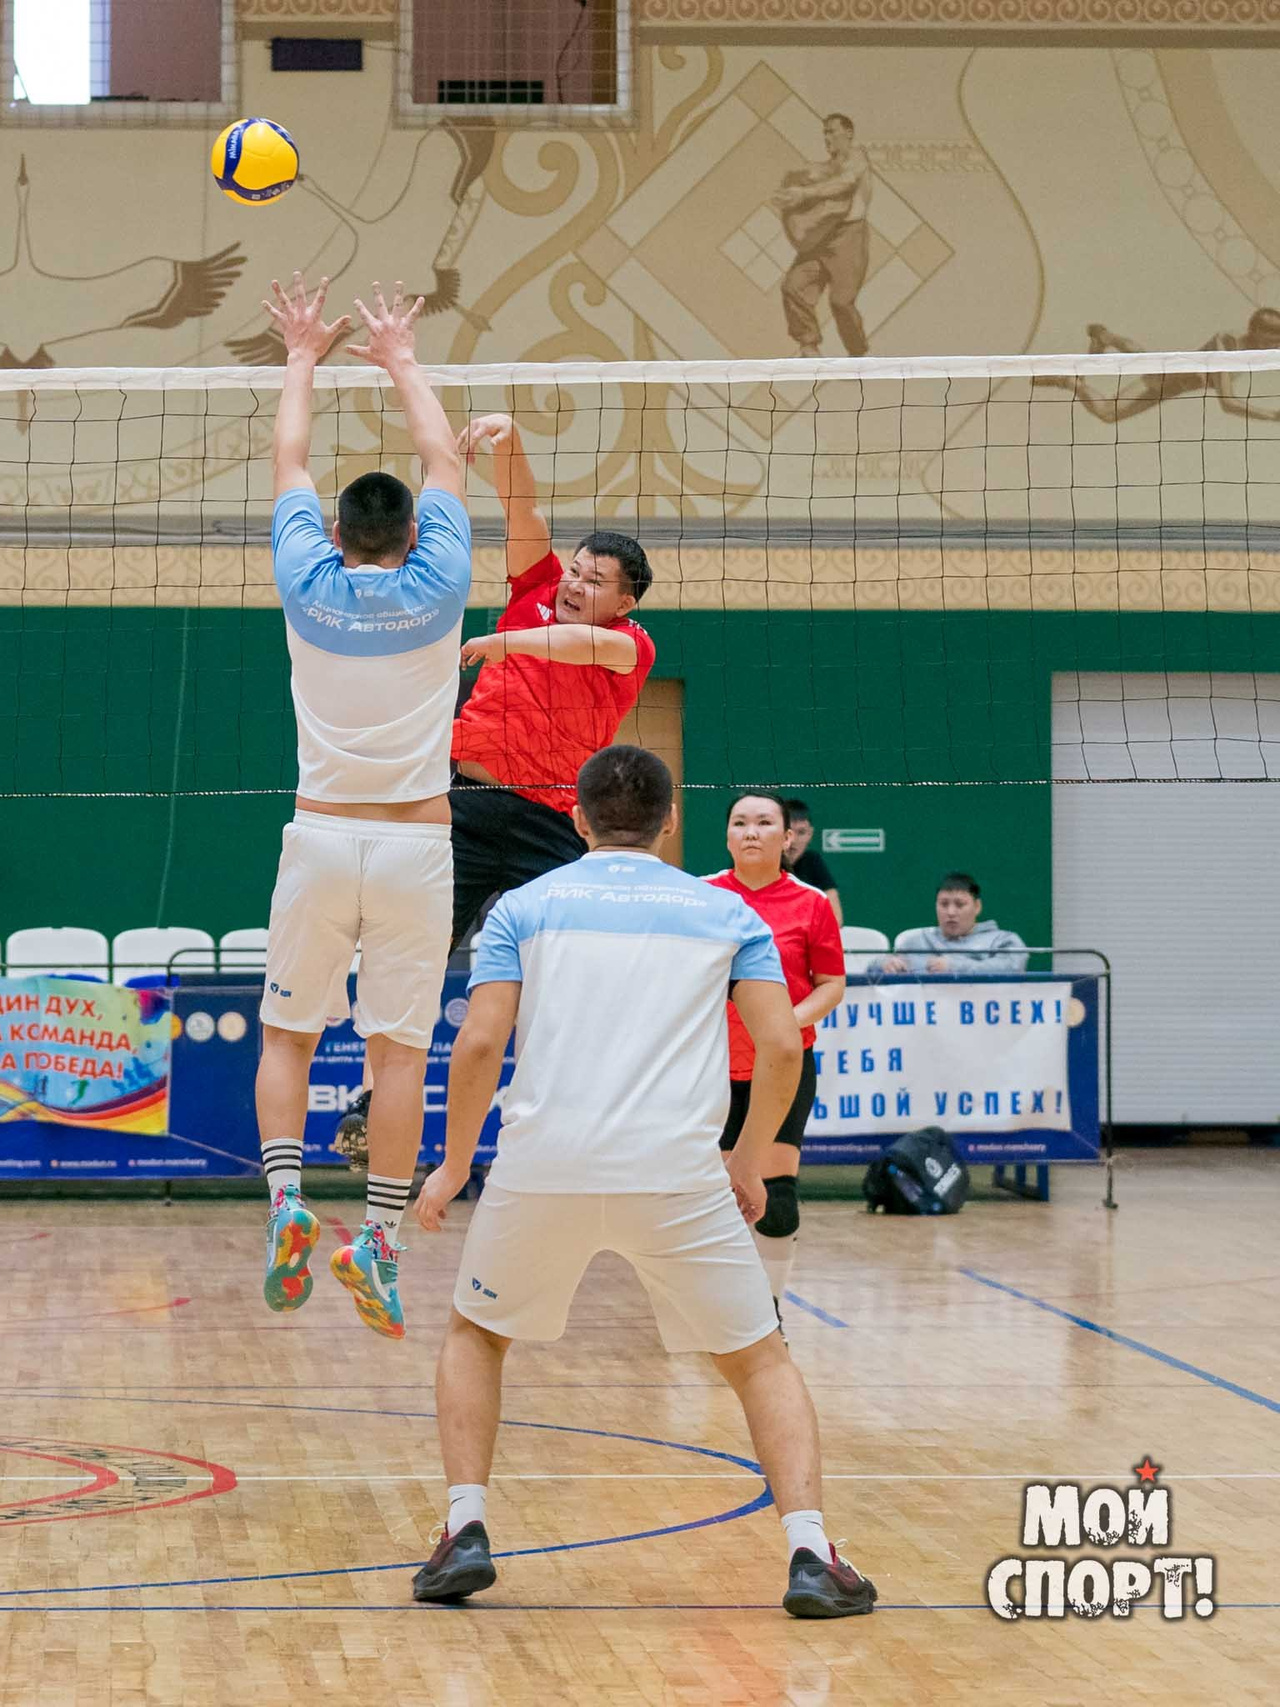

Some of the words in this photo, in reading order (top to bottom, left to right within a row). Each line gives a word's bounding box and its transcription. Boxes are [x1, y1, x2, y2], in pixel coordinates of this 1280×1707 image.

[347, 608, 440, 632] Автодор»
[45, 994, 104, 1021] ДУХ,
[959, 999, 1062, 1026] ВСЕХ!
[24, 1052, 124, 1079] ПОБЕДА!
[934, 1090, 1063, 1117] УСПЕХ!
